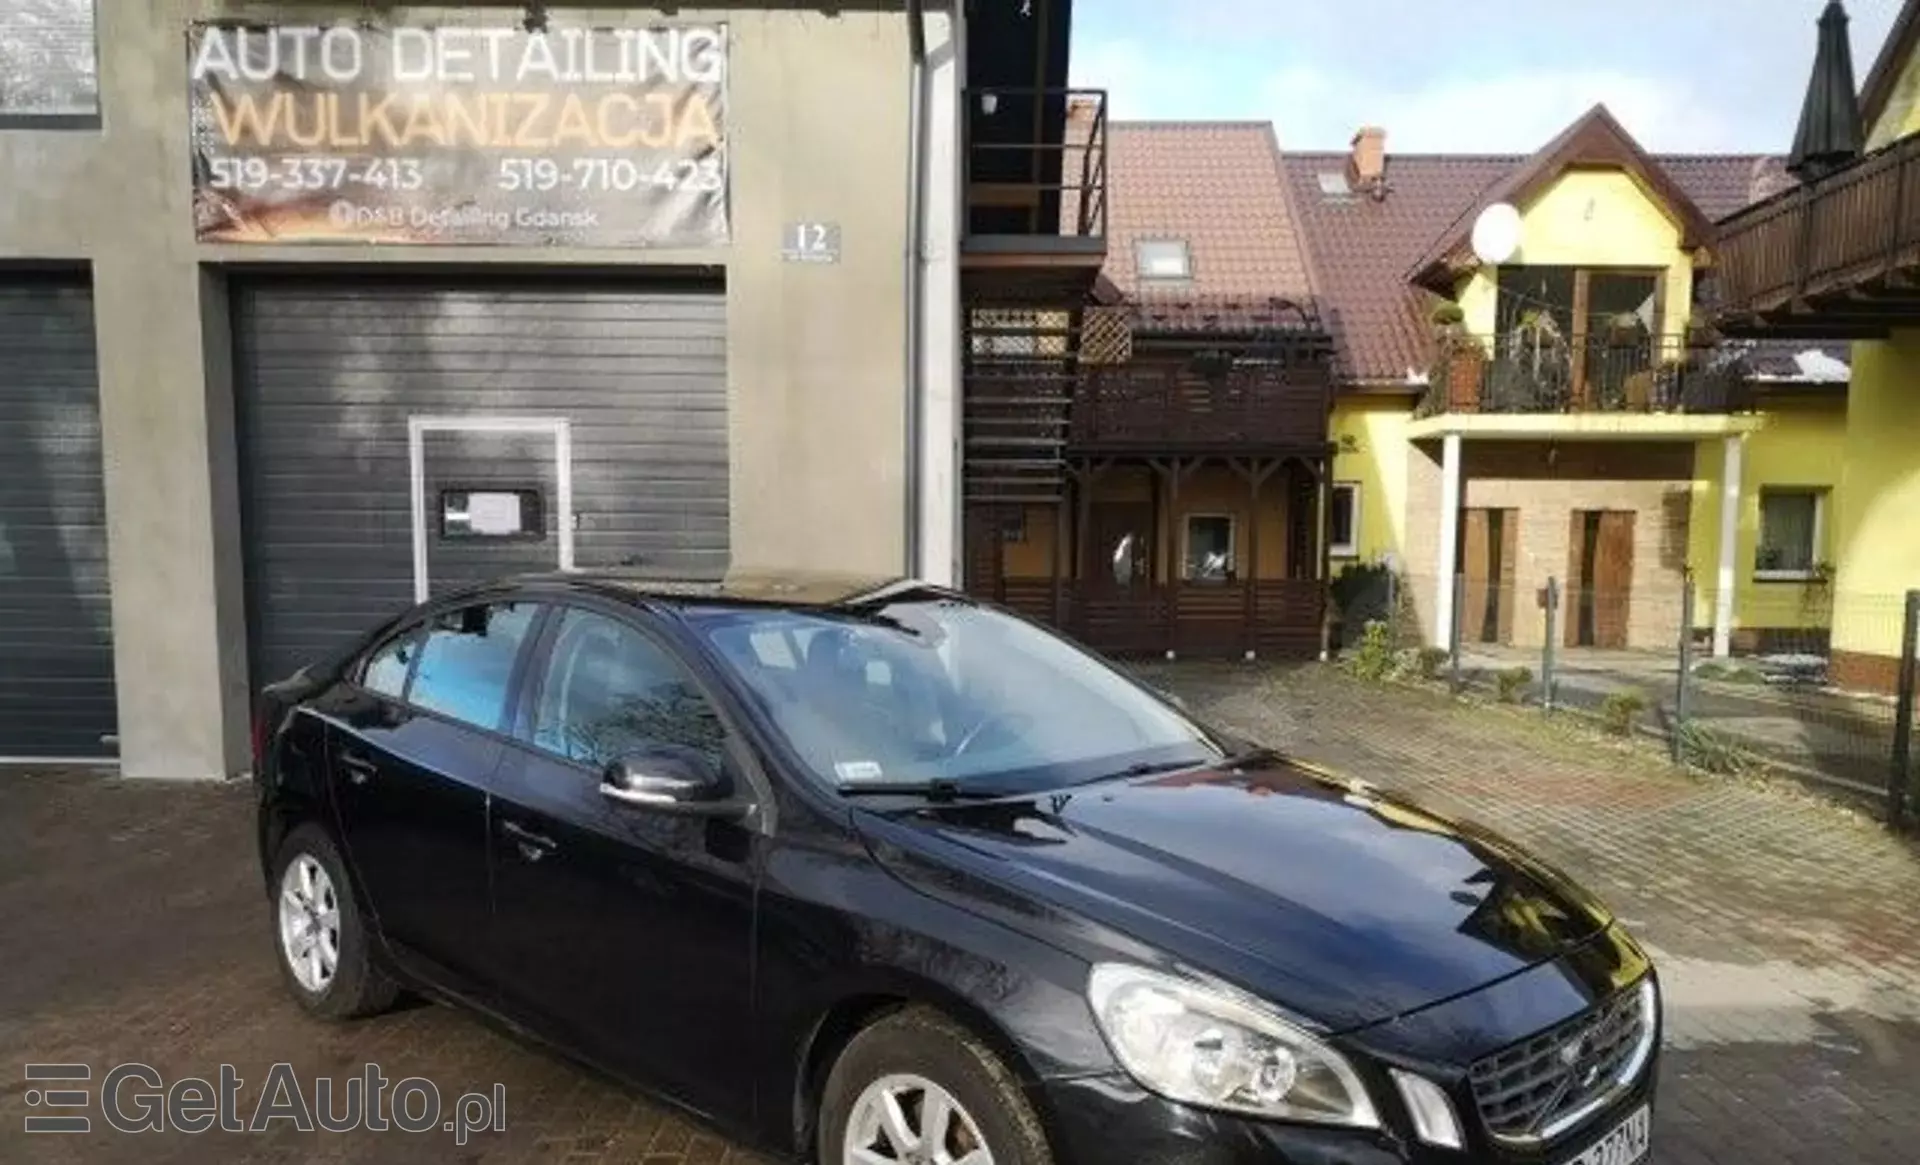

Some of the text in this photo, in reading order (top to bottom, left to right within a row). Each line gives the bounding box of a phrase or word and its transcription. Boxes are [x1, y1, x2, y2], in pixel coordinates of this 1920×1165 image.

[194, 26, 722, 82] AUTO DETAILING
[209, 90, 719, 147] WULKANIZACJA
[210, 156, 722, 191] 519-337-413 519-710-423
[410, 204, 510, 231] Detailing
[797, 223, 827, 251] 12
